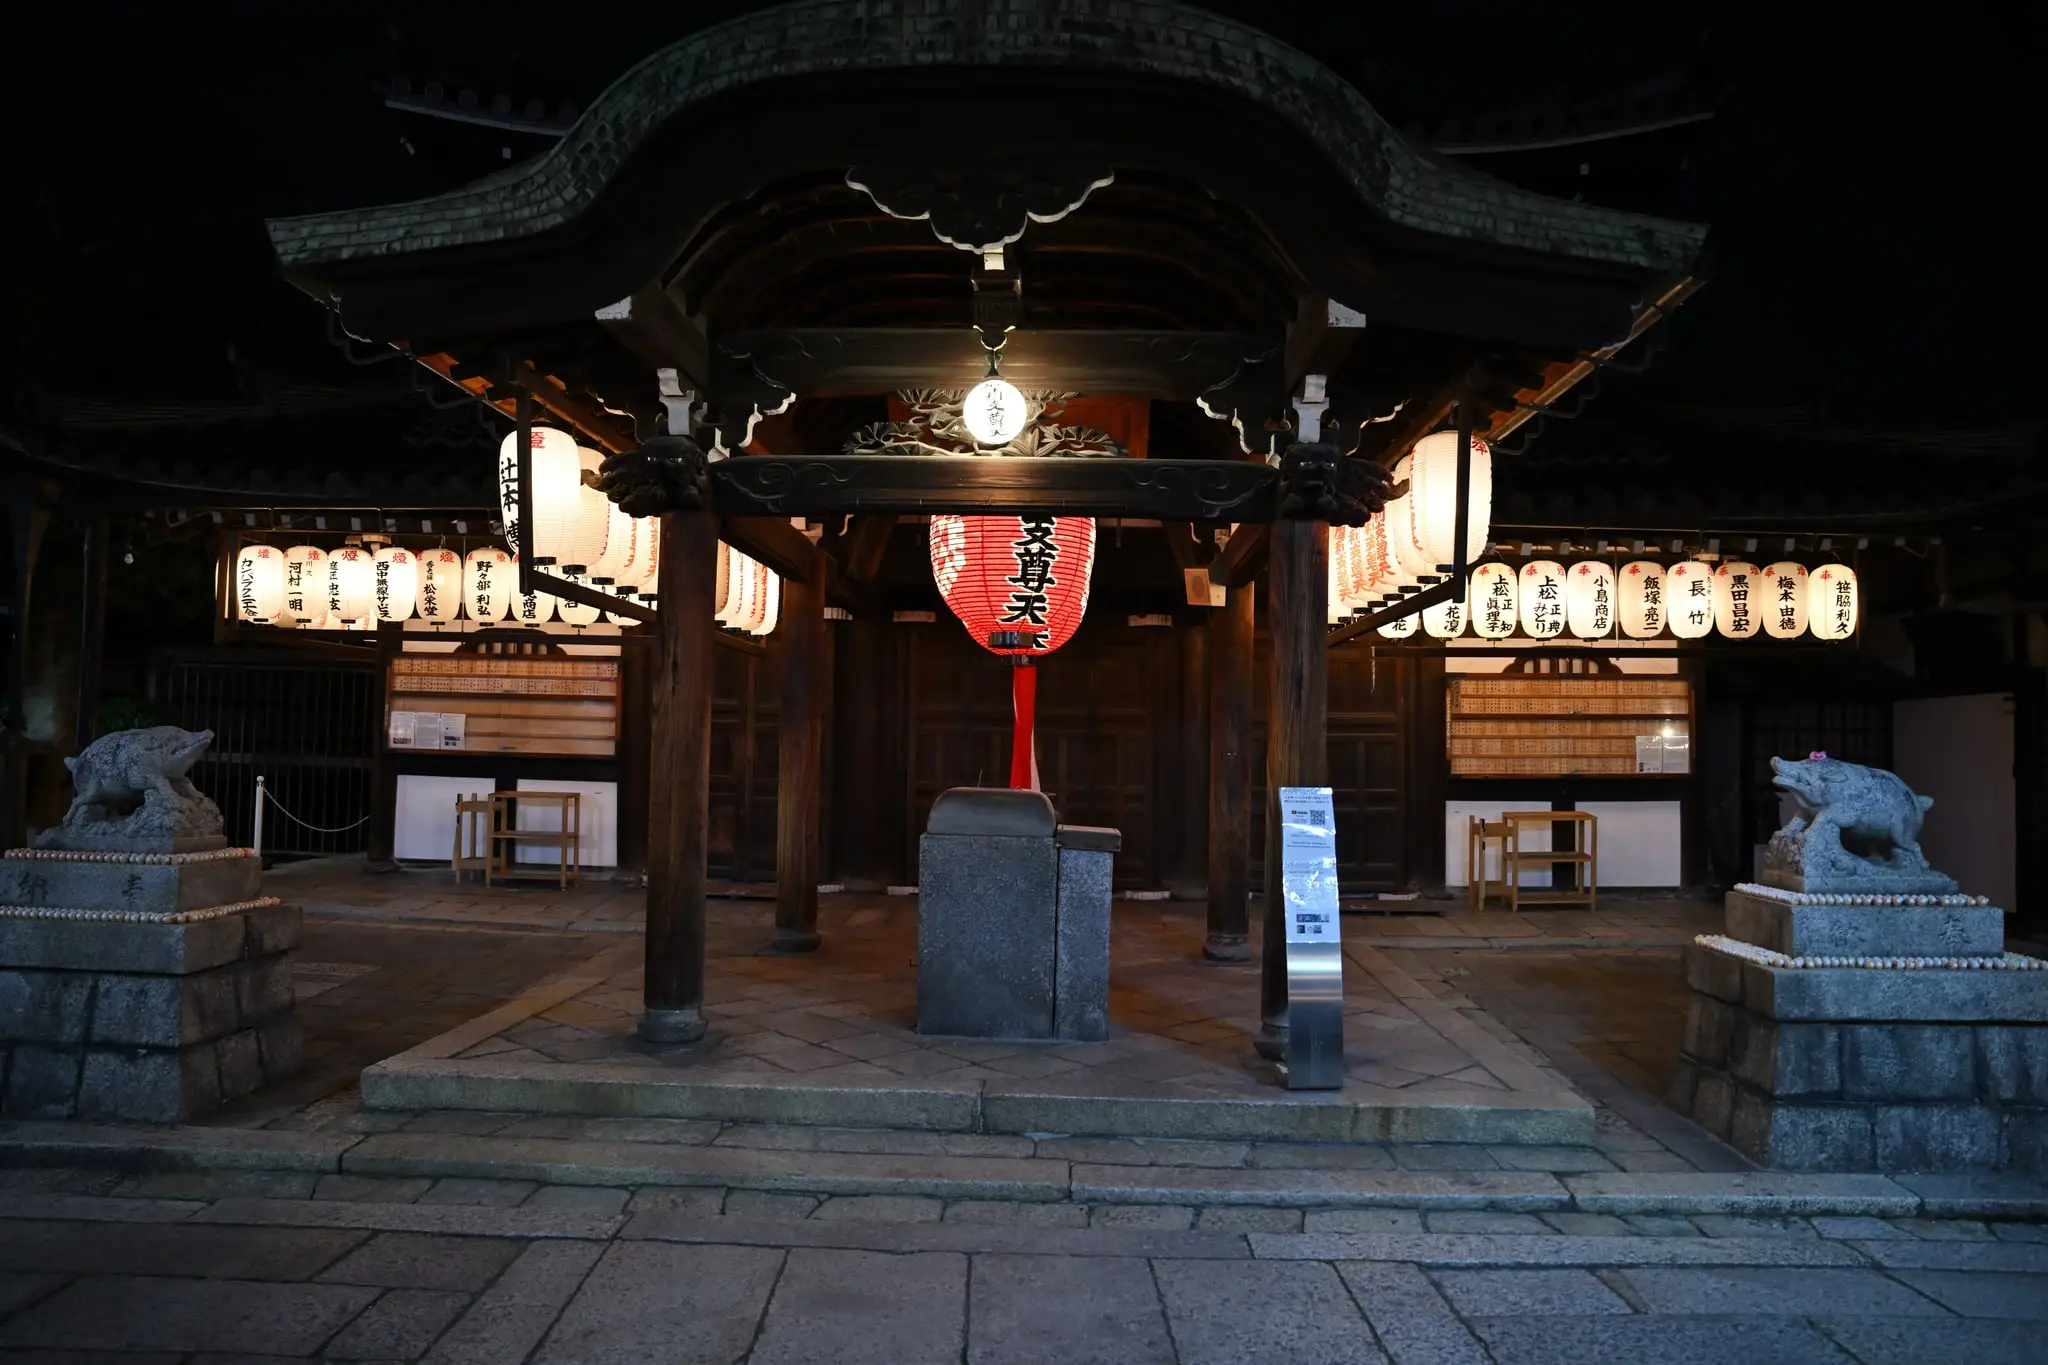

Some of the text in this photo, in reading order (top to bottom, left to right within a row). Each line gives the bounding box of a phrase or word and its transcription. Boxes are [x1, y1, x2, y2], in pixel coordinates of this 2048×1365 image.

[342, 550, 359, 561] 燈
[392, 552, 407, 564] 燈
[440, 551, 455, 563] 燈
[288, 562, 303, 612] 河村一明
[423, 583, 438, 617] 松栄堂
[476, 560, 493, 617] 野々部利弘
[1491, 574, 1510, 597] 上松
[1538, 575, 1558, 600] 上松
[1592, 574, 1609, 630] 小島商店
[1687, 579, 1706, 625] 長竹
[1500, 598, 1513, 633] 正知
[1533, 602, 1548, 634] みどり
[1548, 604, 1561, 633] 正典
[1643, 575, 1662, 631] 飯塚亮二
[1730, 574, 1750, 632] 黒田昌宏
[1776, 575, 1796, 631] 梅本由徳
